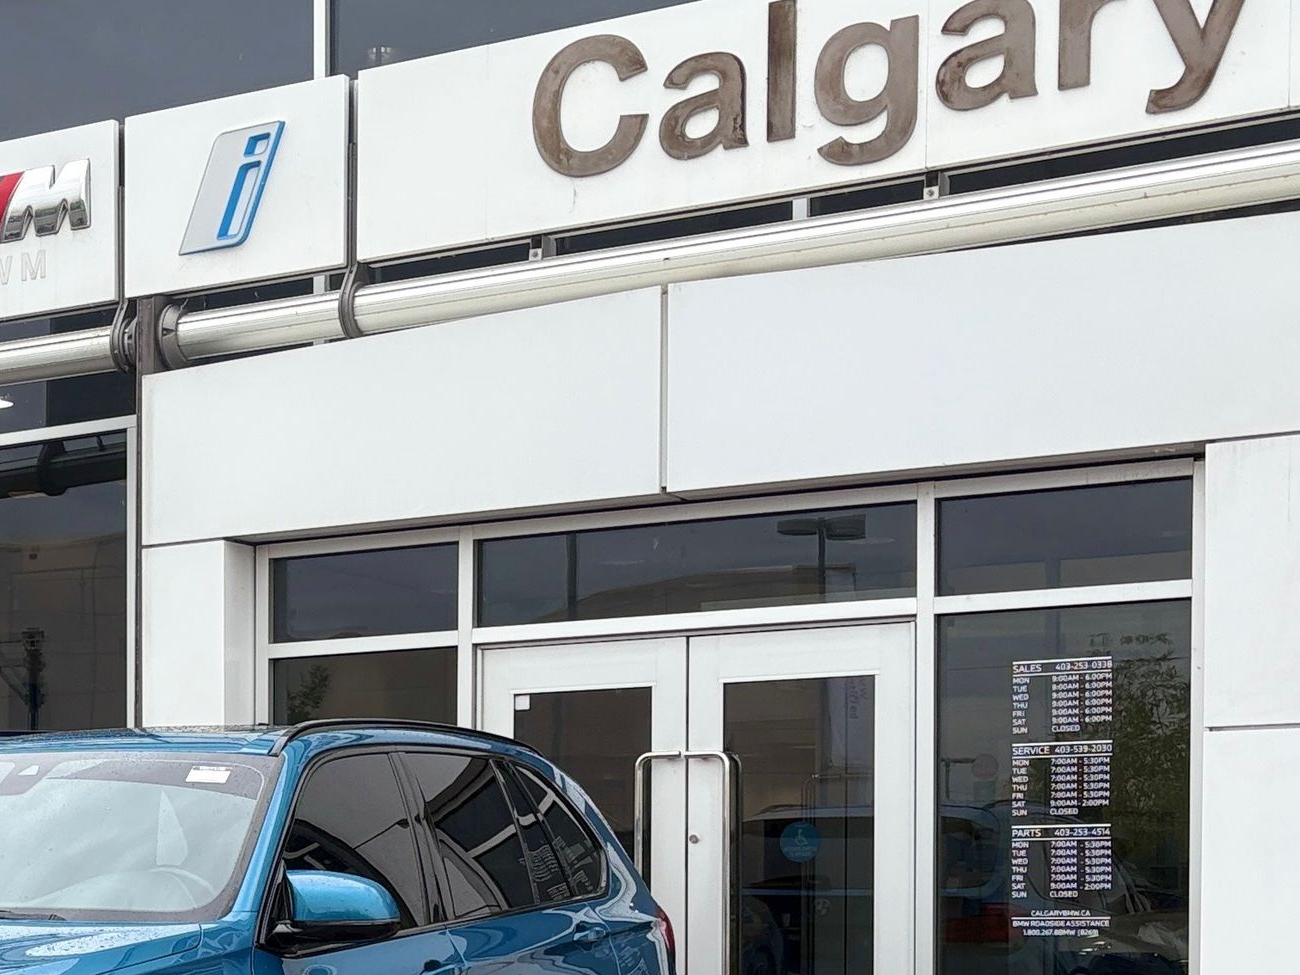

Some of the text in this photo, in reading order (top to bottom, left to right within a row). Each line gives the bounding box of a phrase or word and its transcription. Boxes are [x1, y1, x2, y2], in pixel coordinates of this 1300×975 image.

[532, 0, 1246, 177] Calgary
[20, 249, 47, 281] M
[1013, 665, 1042, 673] SALES
[1012, 745, 1112, 755] SERVICE 403-539-2030
[1012, 829, 1041, 837] PARTS
